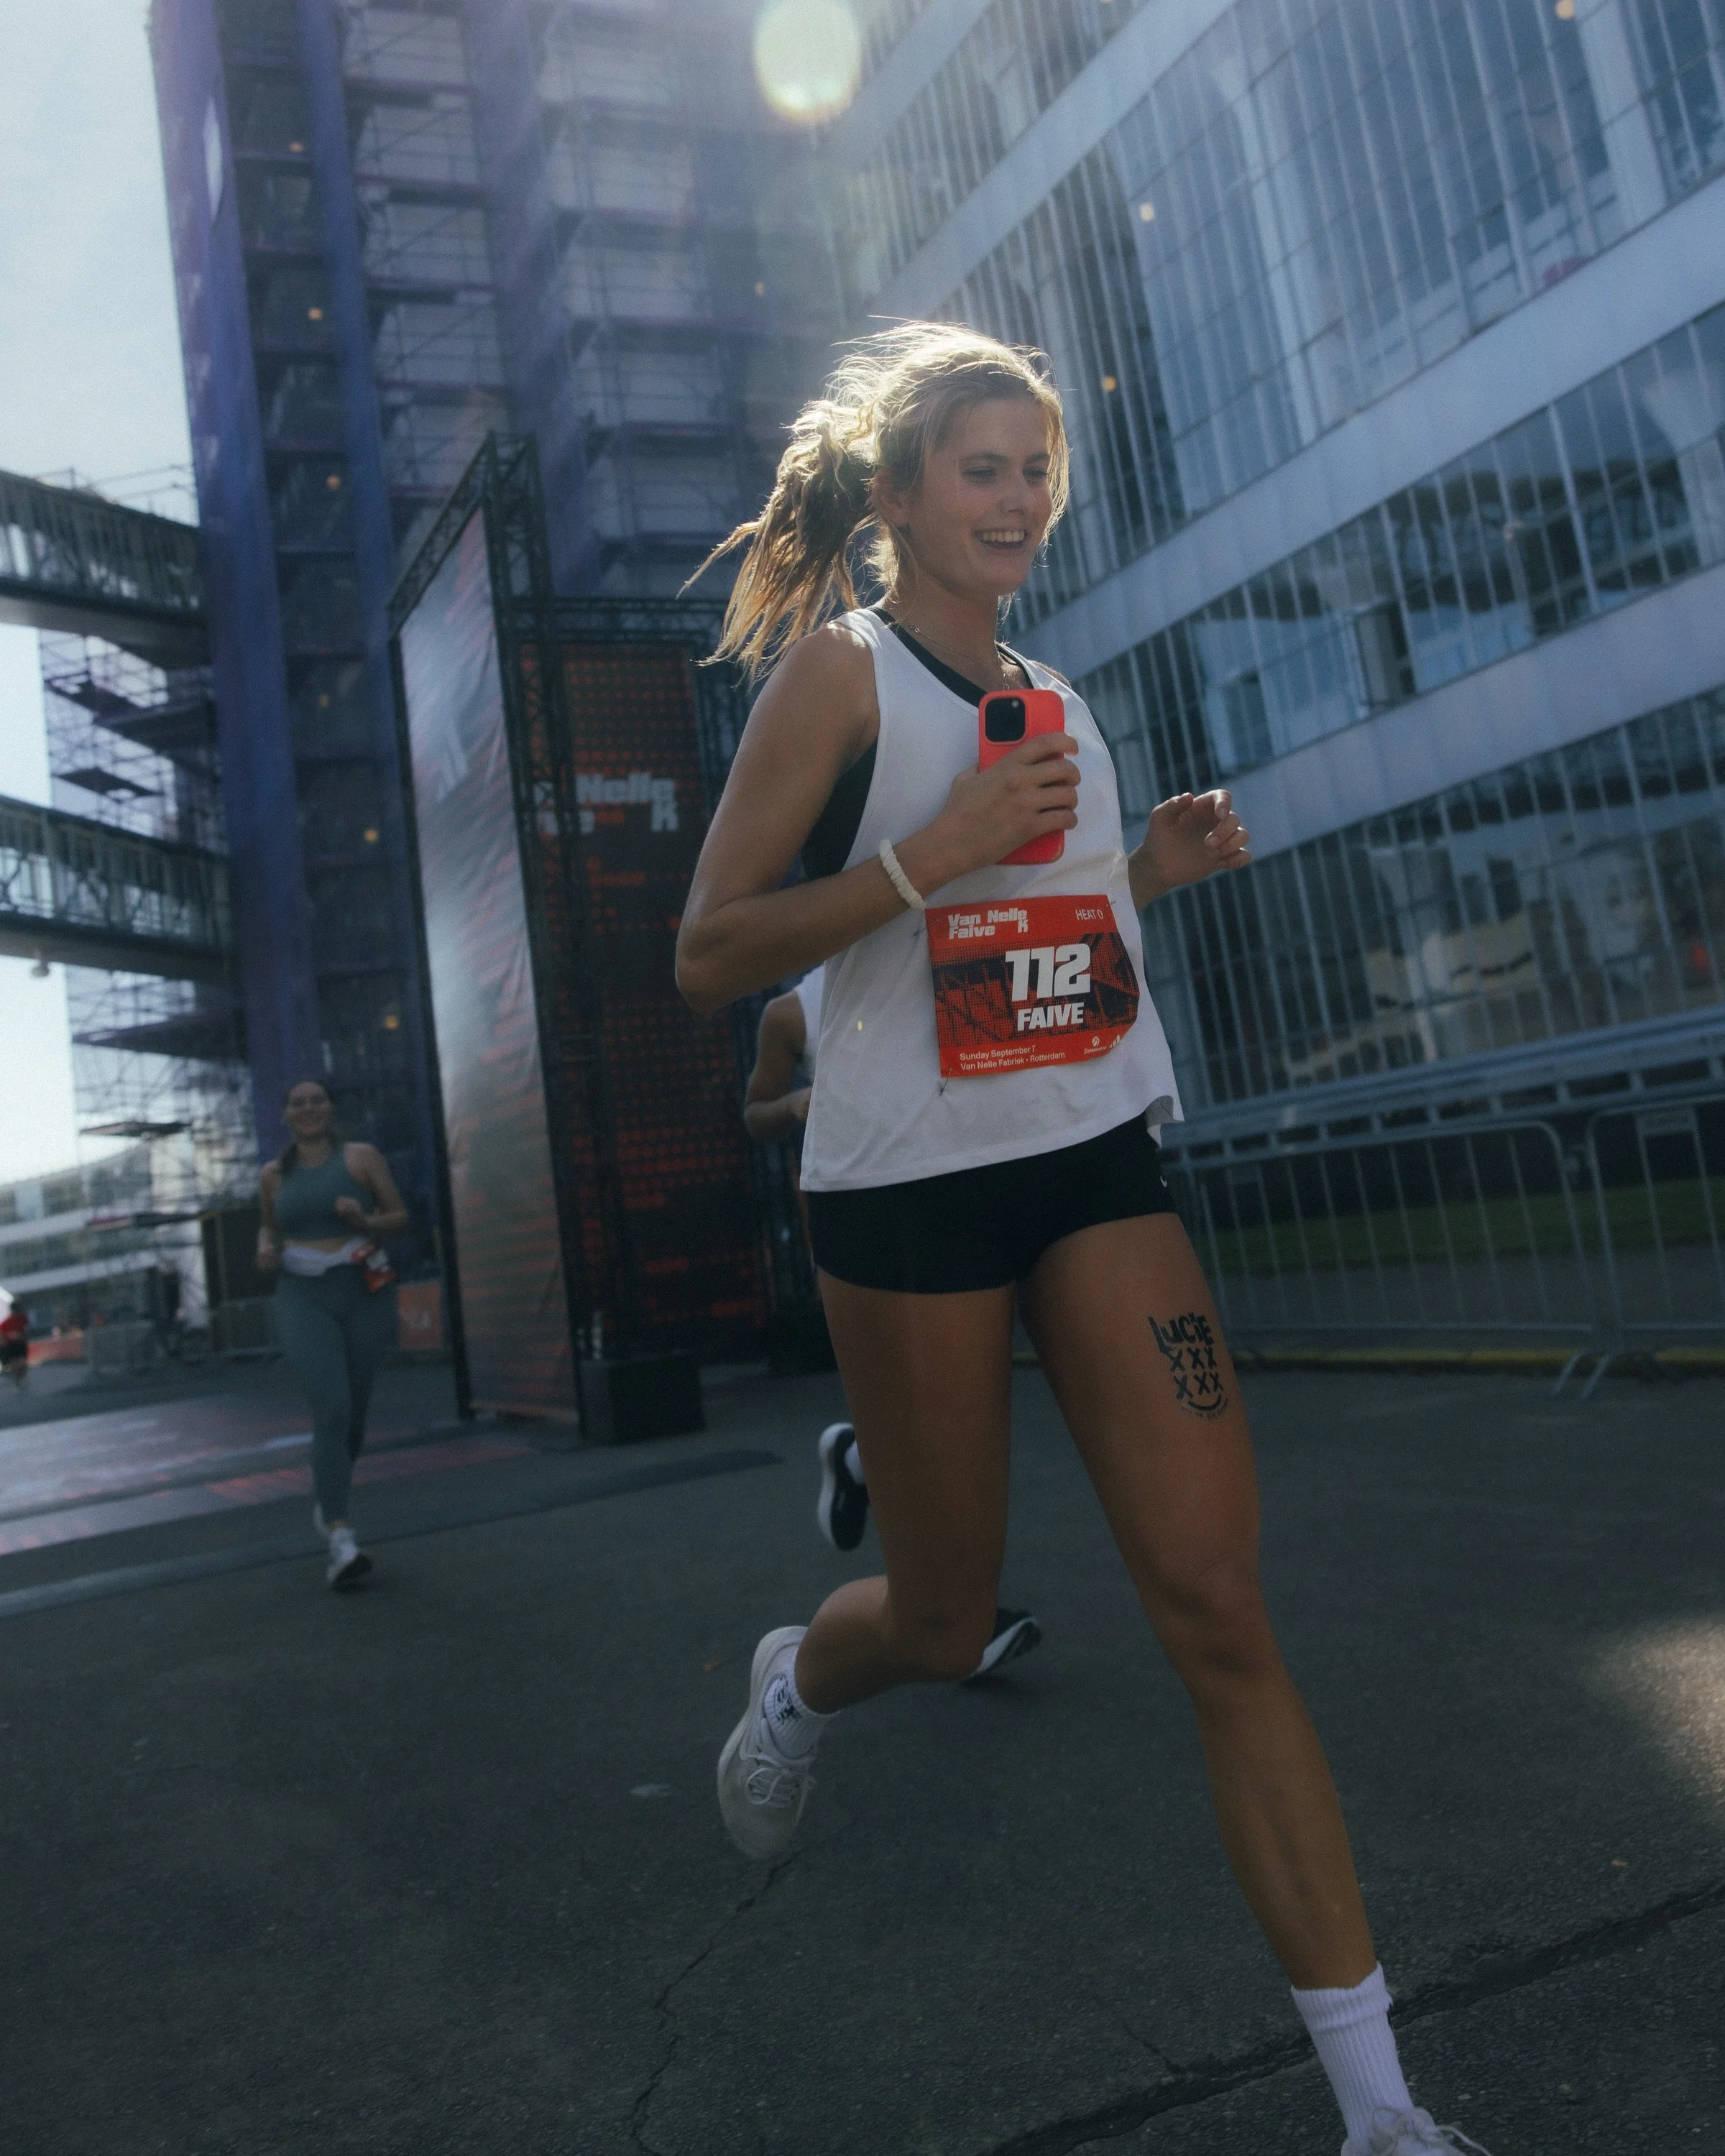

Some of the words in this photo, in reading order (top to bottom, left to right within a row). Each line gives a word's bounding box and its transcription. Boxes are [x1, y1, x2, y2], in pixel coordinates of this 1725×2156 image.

[947, 913, 981, 927] Van
[987, 908, 1028, 923] Nelle
[1075, 909, 1096, 921] HEAT
[948, 925, 995, 940] Faive
[1017, 919, 1029, 934] K
[1005, 943, 1091, 1002] 112
[1017, 1002, 1085, 1031] FAIVE
[960, 1051, 990, 1061] Sunday
[990, 1046, 1031, 1058] September
[977, 1061, 997, 1069] Nelle
[998, 1056, 1025, 1067] Fabriek
[1030, 1051, 1065, 1063] Rotterdam
